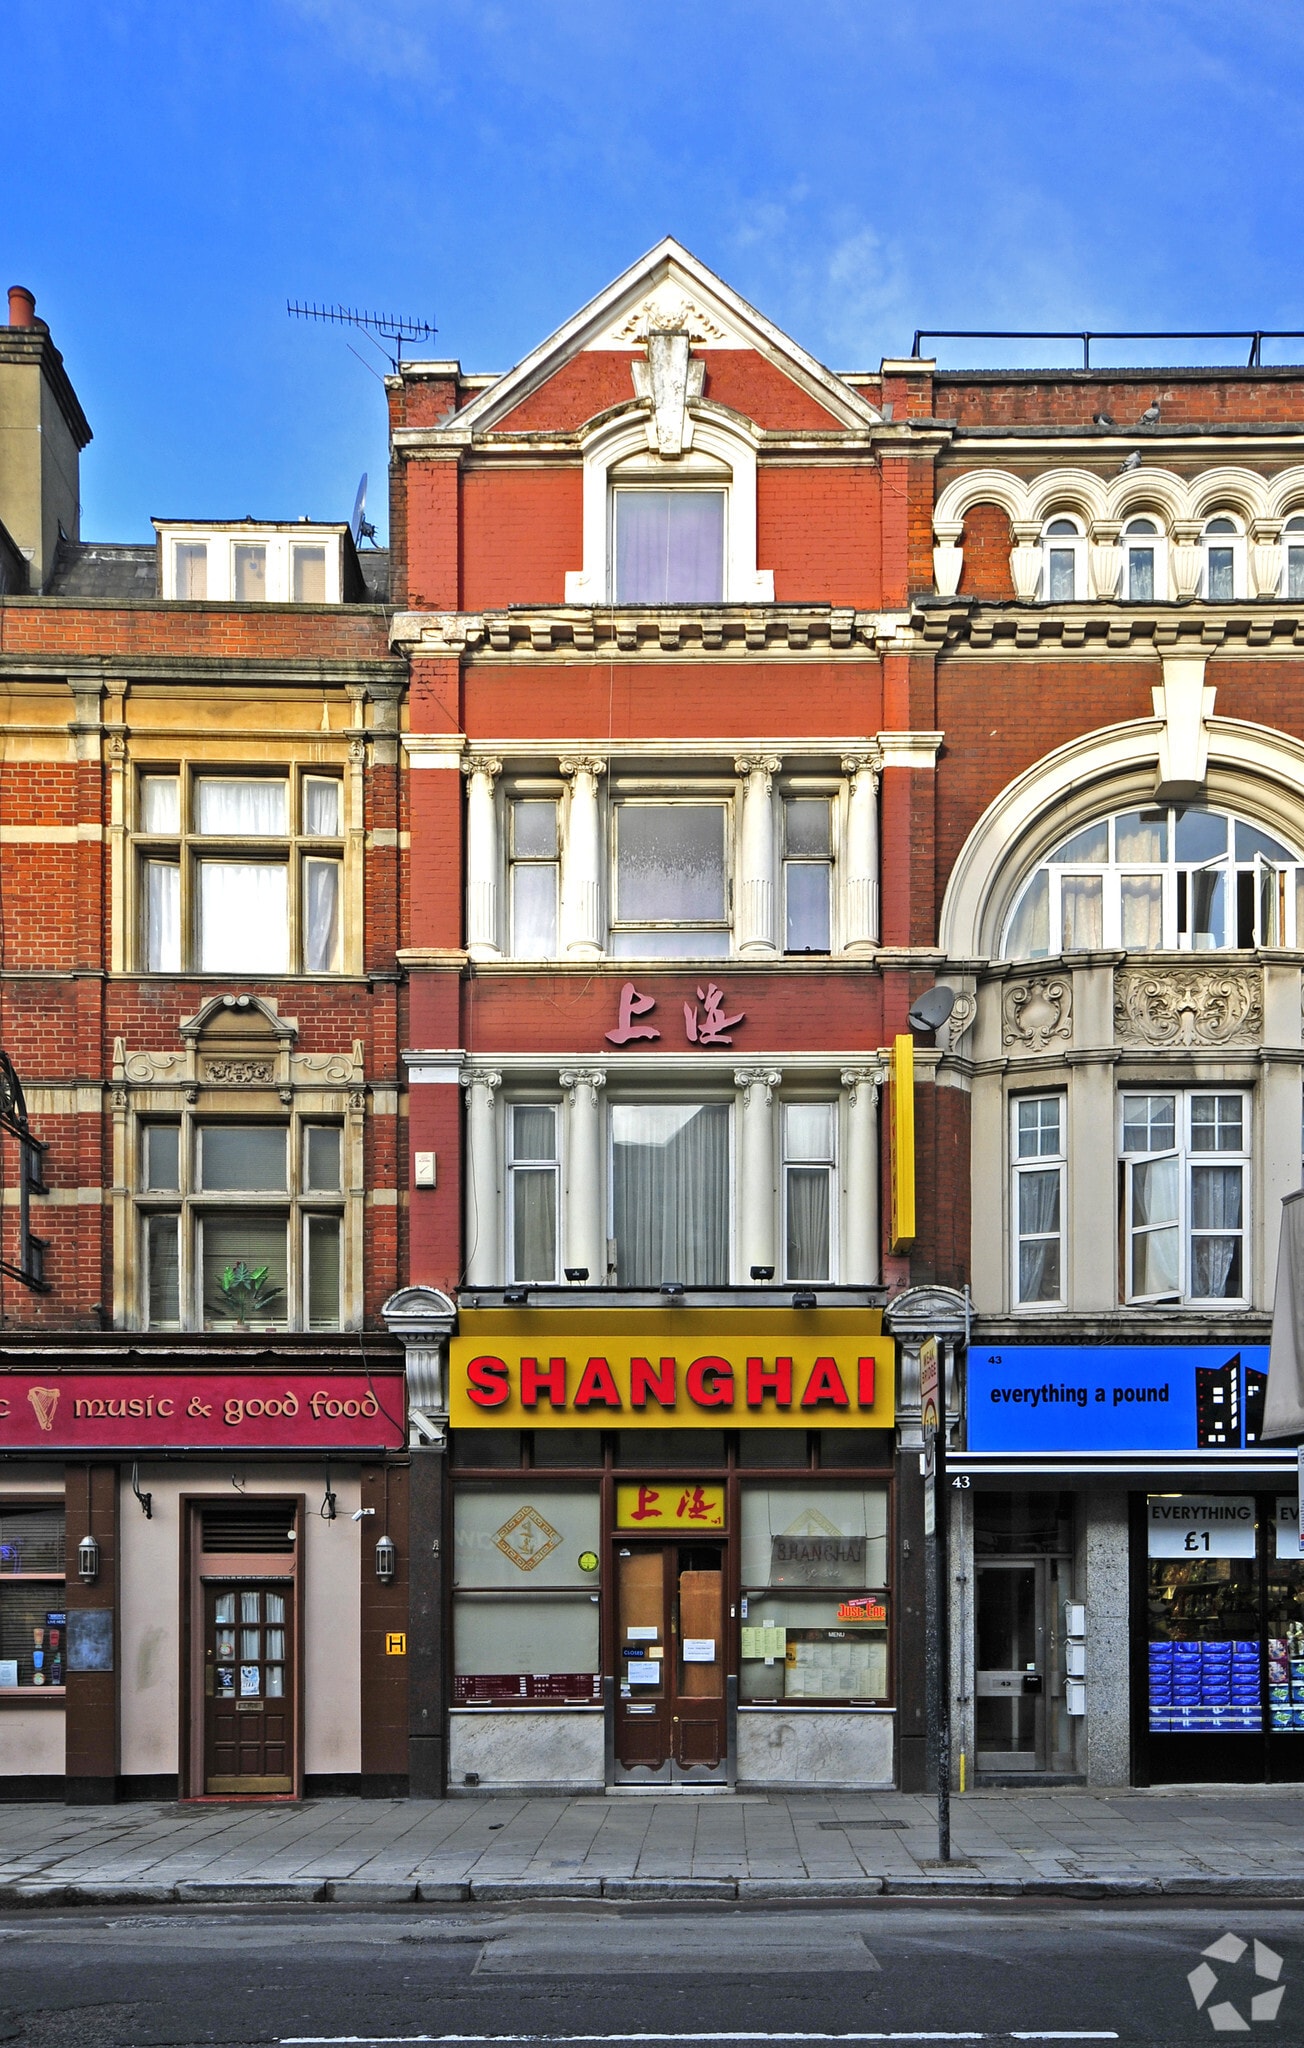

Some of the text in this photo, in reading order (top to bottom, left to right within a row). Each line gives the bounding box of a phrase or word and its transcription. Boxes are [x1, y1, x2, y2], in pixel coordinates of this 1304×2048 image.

[988, 1356, 1002, 1364] 43
[466, 1356, 876, 1406] SHANGHAI
[990, 1384, 1170, 1407] everything a pound
[74, 1391, 380, 1425] music & good food
[952, 1475, 971, 1489] 43
[1152, 1506, 1251, 1520] EVERYTHING
[1184, 1531, 1210, 1551] £1
[389, 1635, 403, 1652] H
